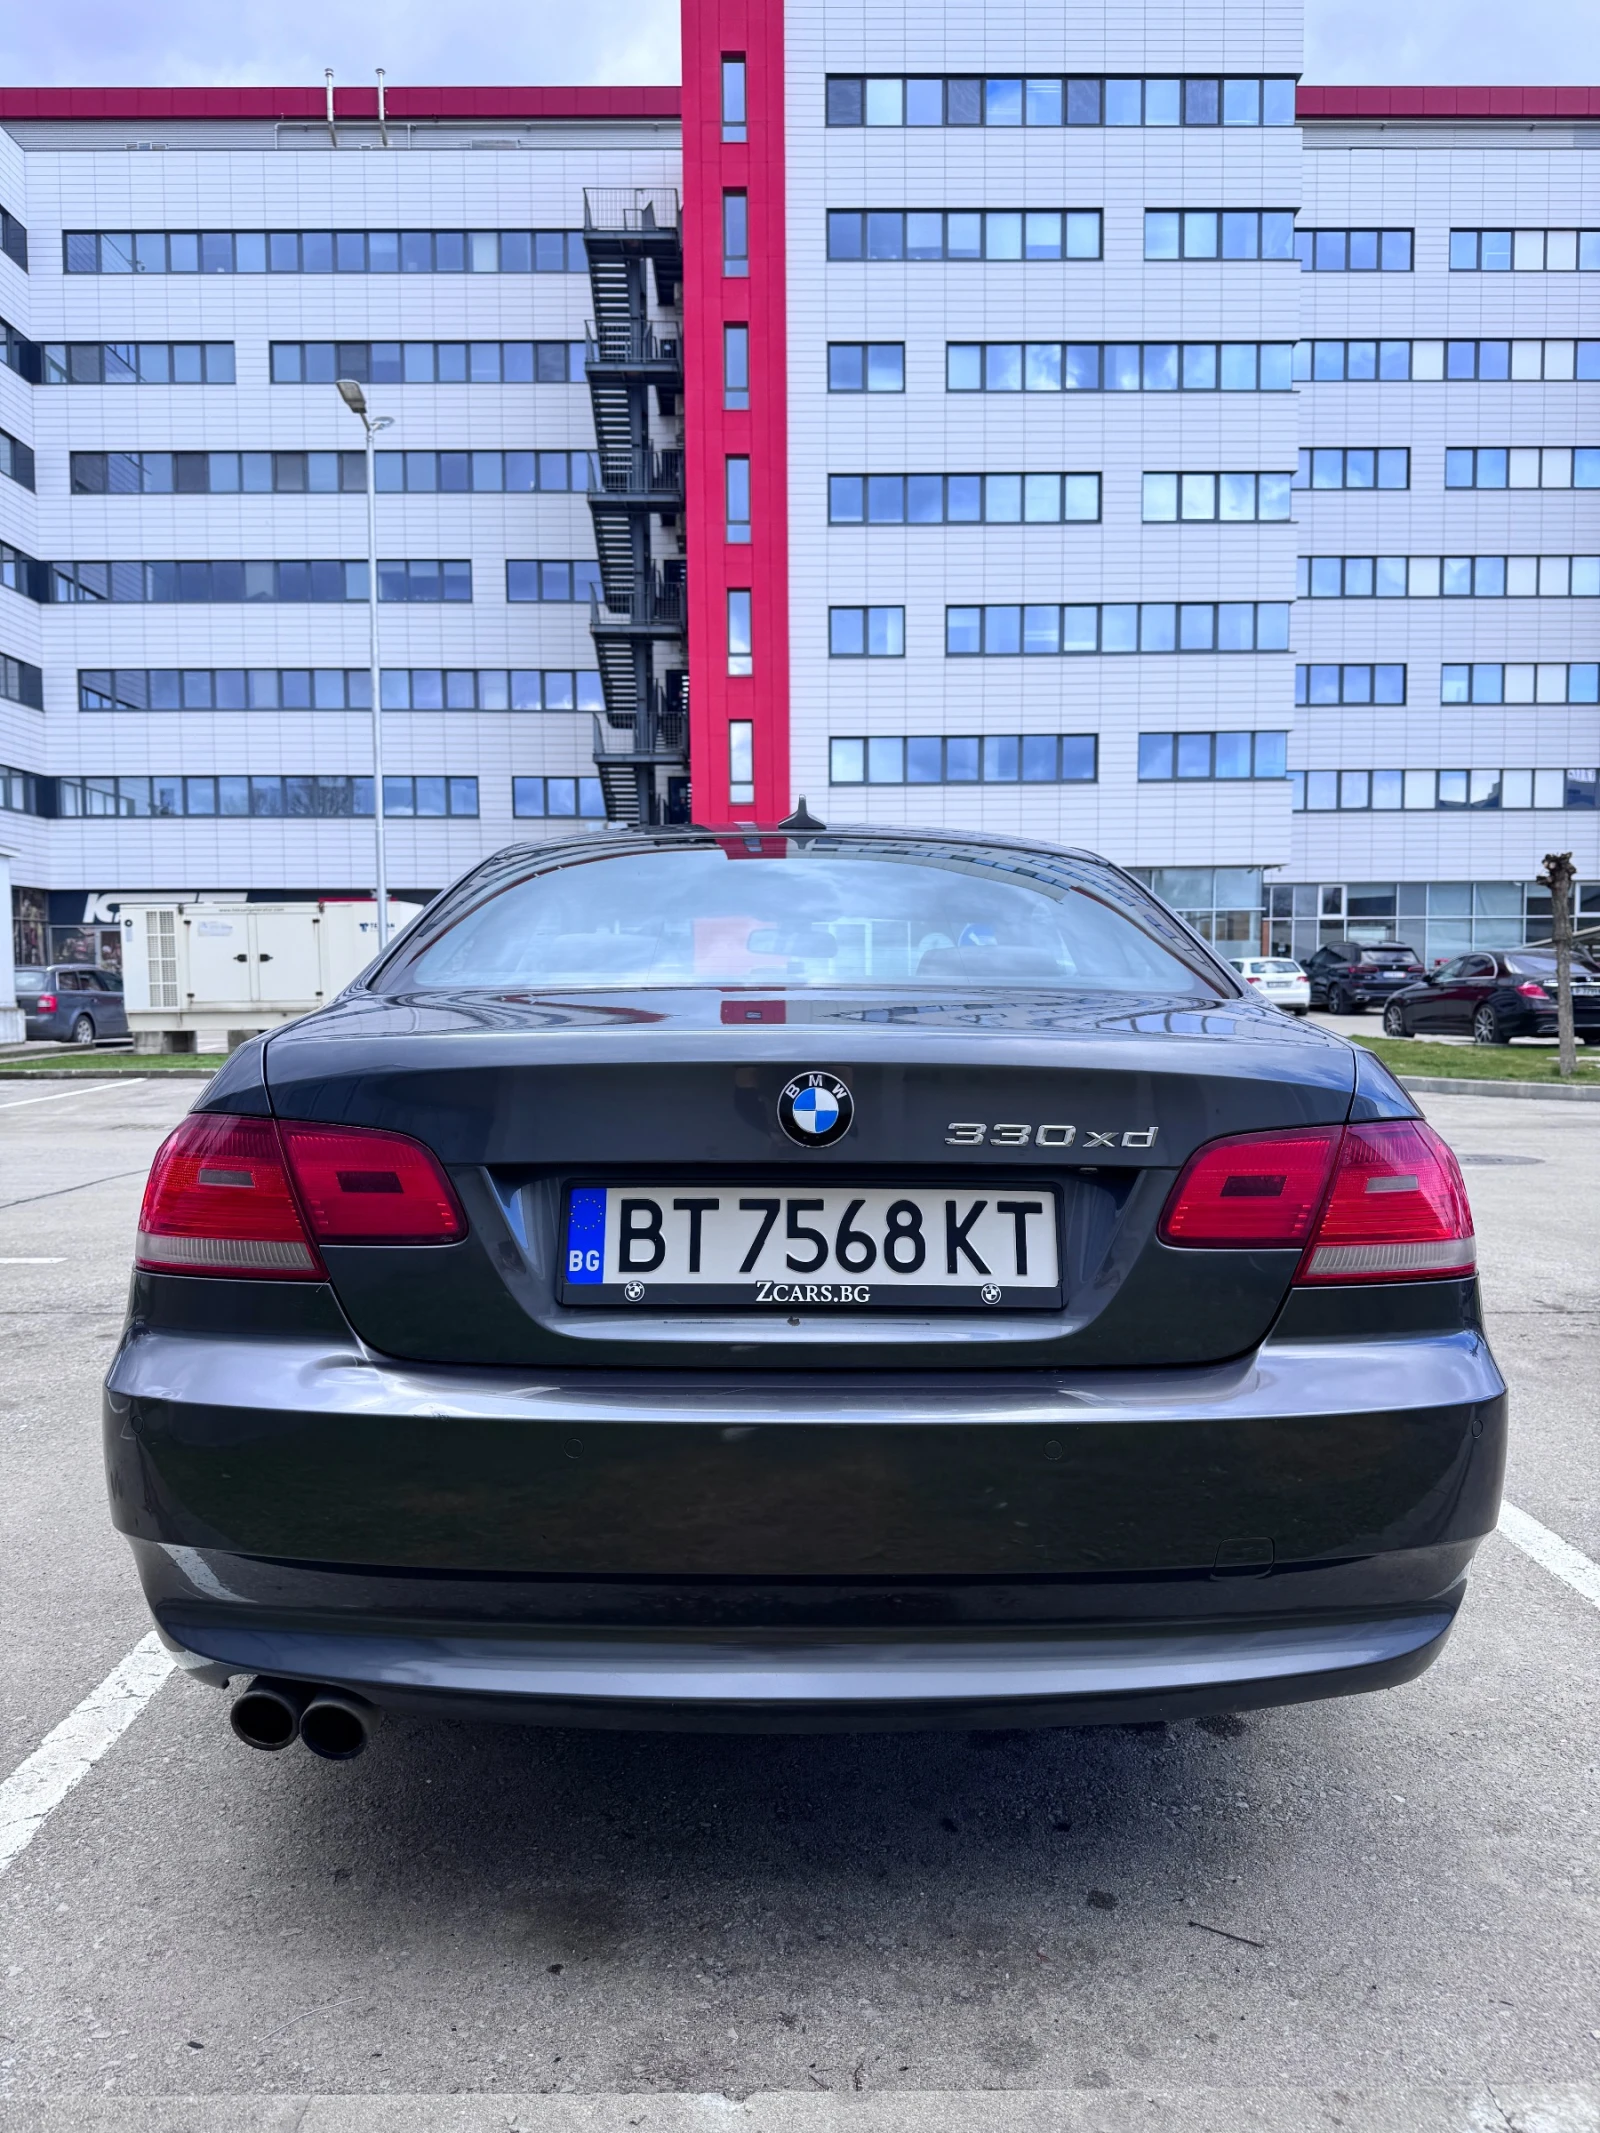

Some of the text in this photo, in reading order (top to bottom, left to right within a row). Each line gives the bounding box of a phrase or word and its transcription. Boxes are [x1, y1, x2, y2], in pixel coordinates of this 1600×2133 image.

[785, 1074, 848, 1099] BMW
[618, 1198, 1043, 1276] BT 7568 KT
[569, 1249, 600, 1273] BG
